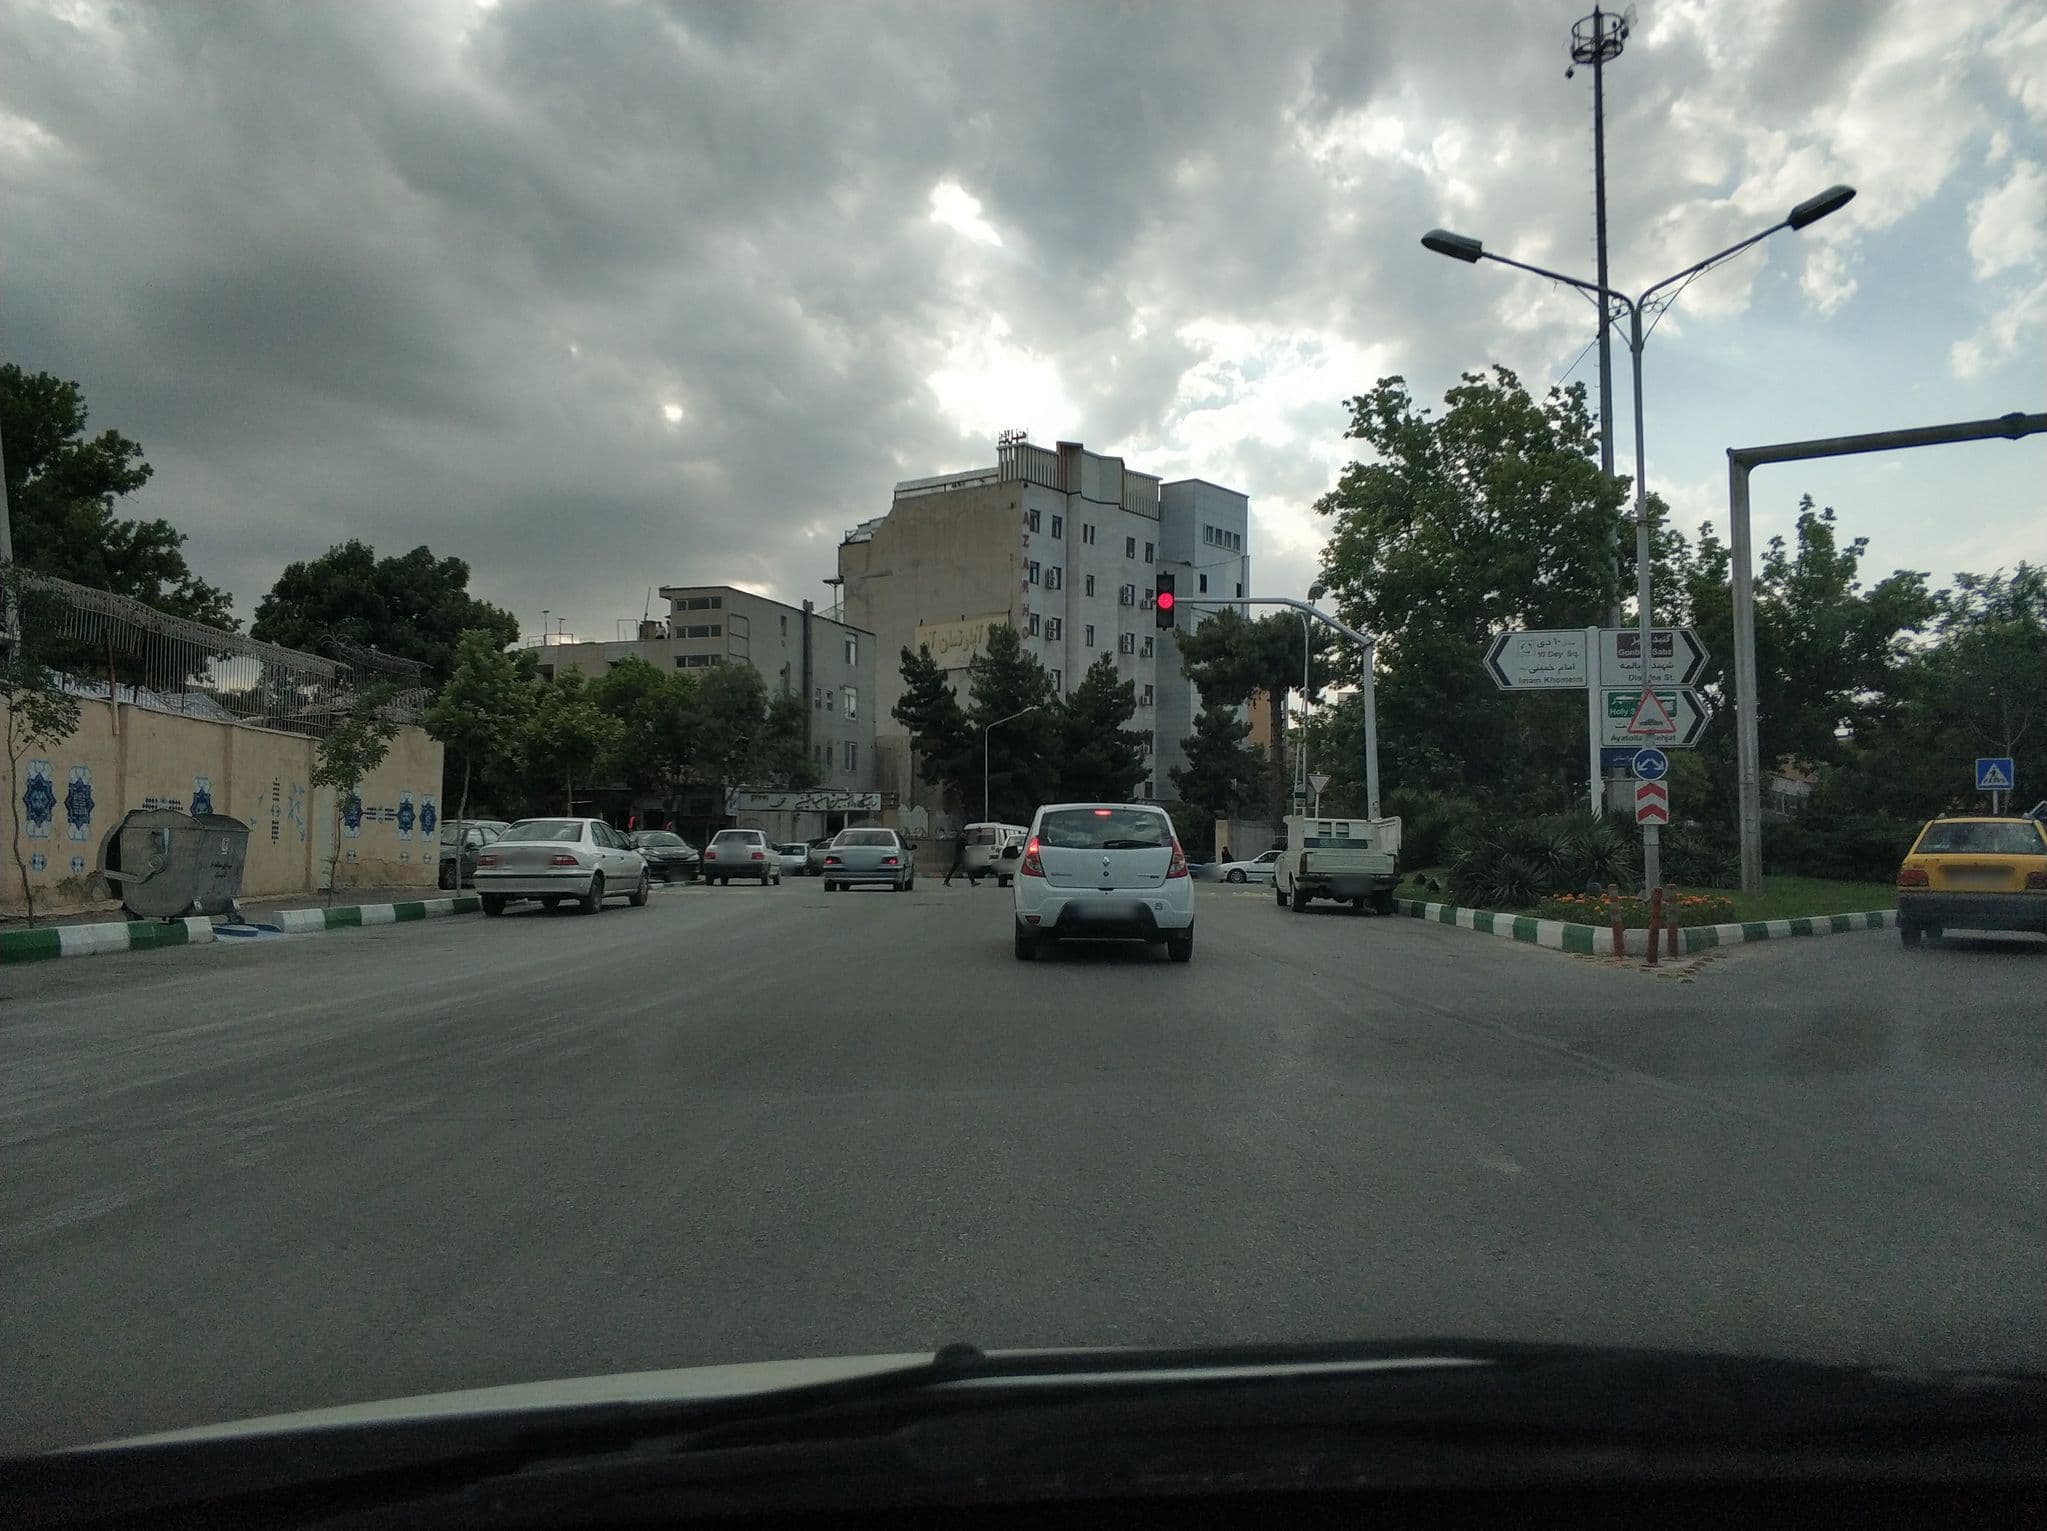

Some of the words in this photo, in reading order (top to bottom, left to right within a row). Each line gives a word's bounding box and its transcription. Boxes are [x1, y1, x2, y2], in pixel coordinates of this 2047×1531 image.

[1547, 651, 1564, 659] Dey
[1558, 663, 1576, 674] امام
[1609, 708, 1629, 717] Holy
